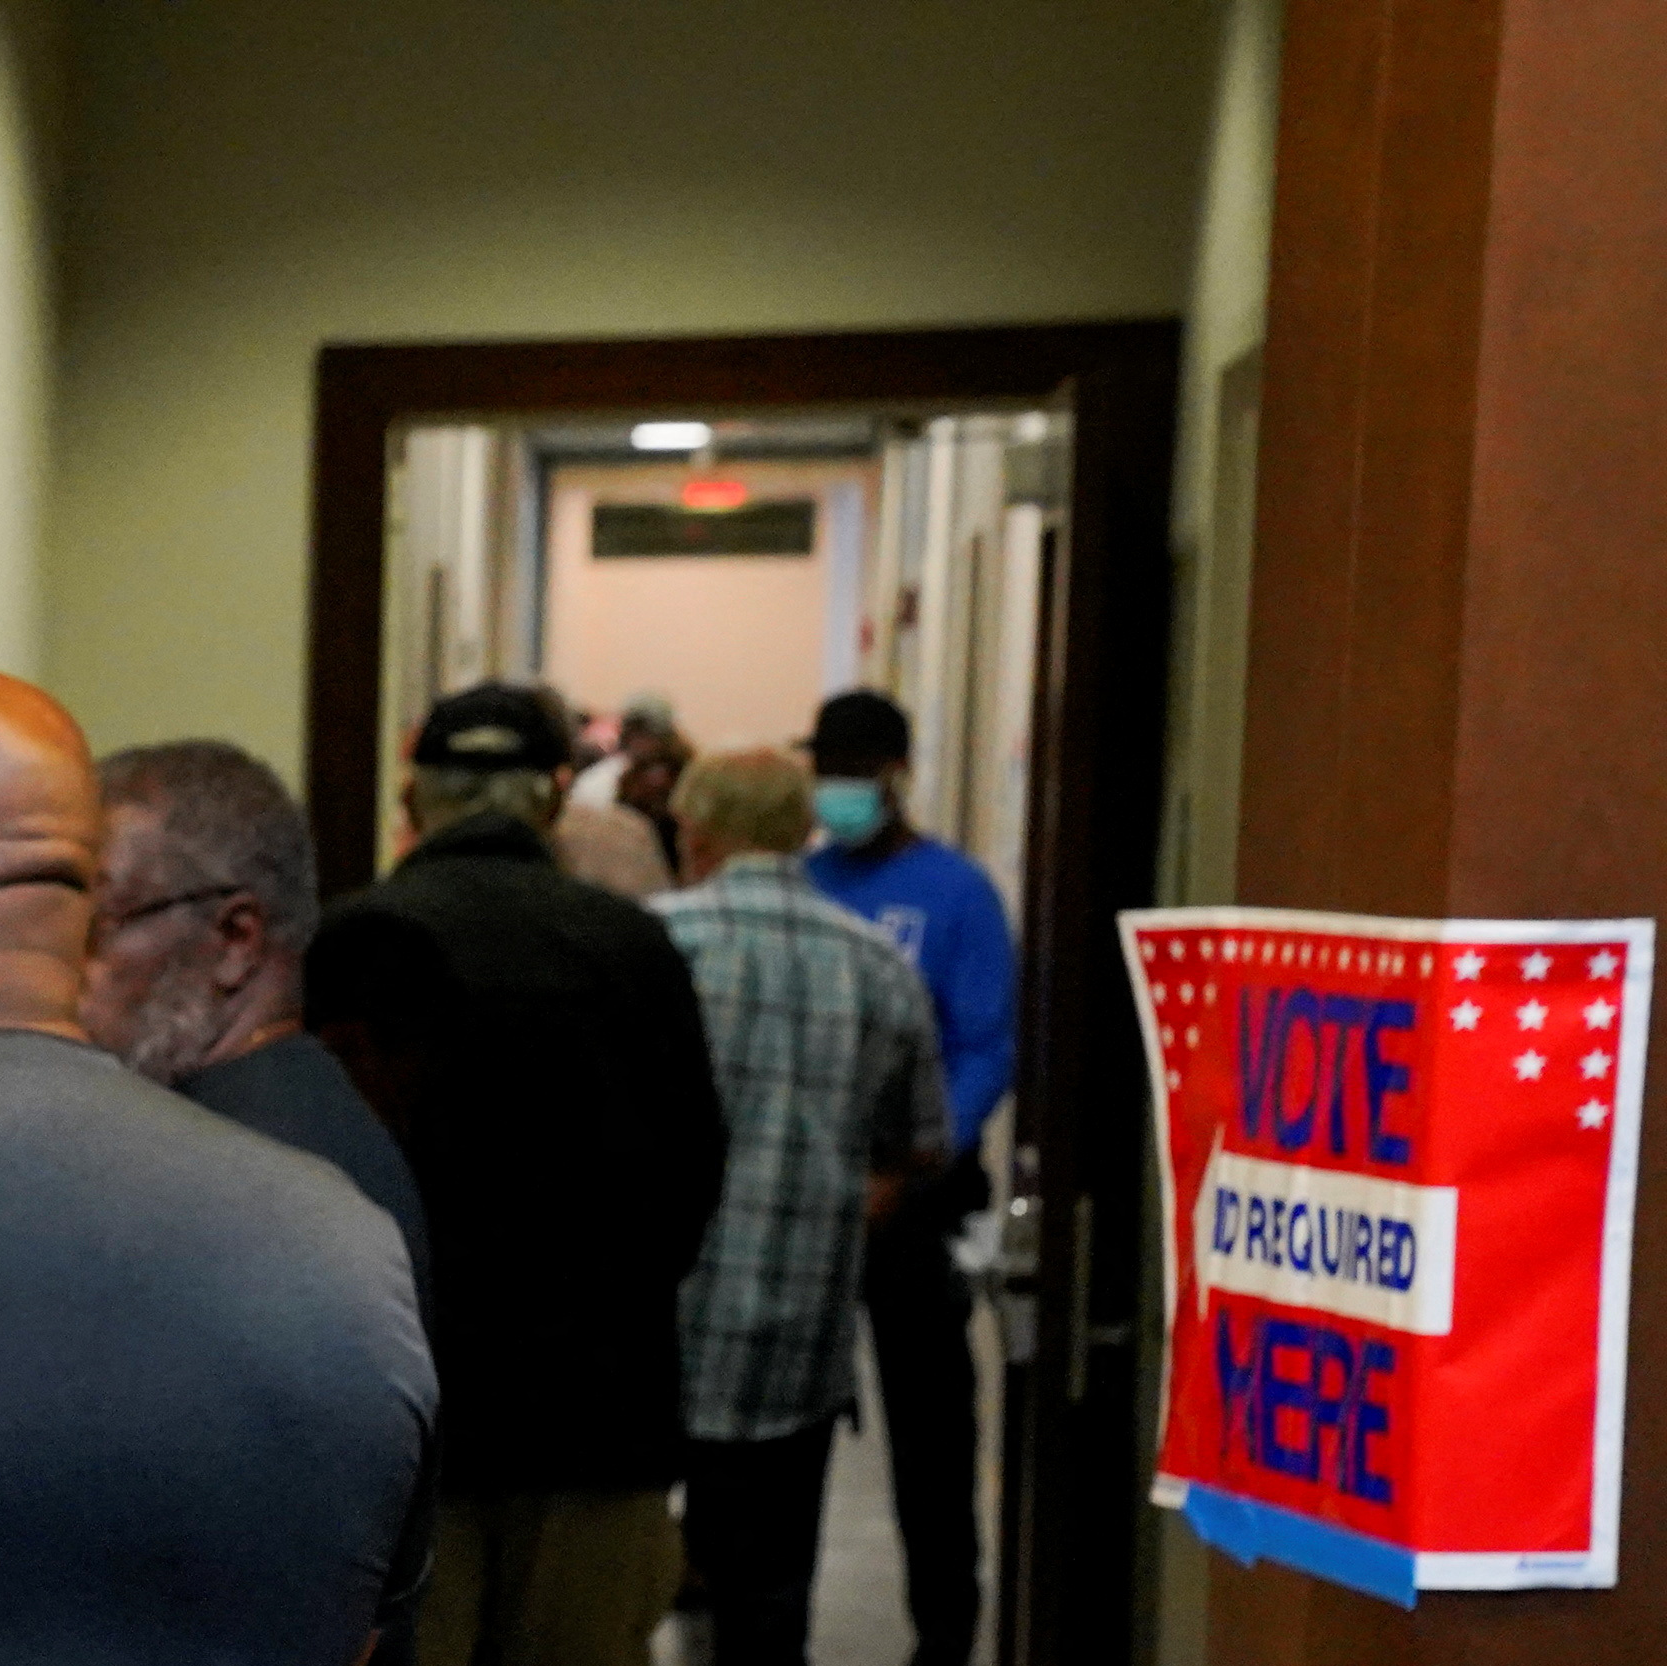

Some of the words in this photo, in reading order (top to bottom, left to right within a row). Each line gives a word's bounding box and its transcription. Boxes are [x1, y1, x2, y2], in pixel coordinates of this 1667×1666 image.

[1238, 987, 1417, 1166] VOTE
[1246, 1192, 1418, 1293] REQUIRED
[1215, 1308, 1396, 1505] HERE
